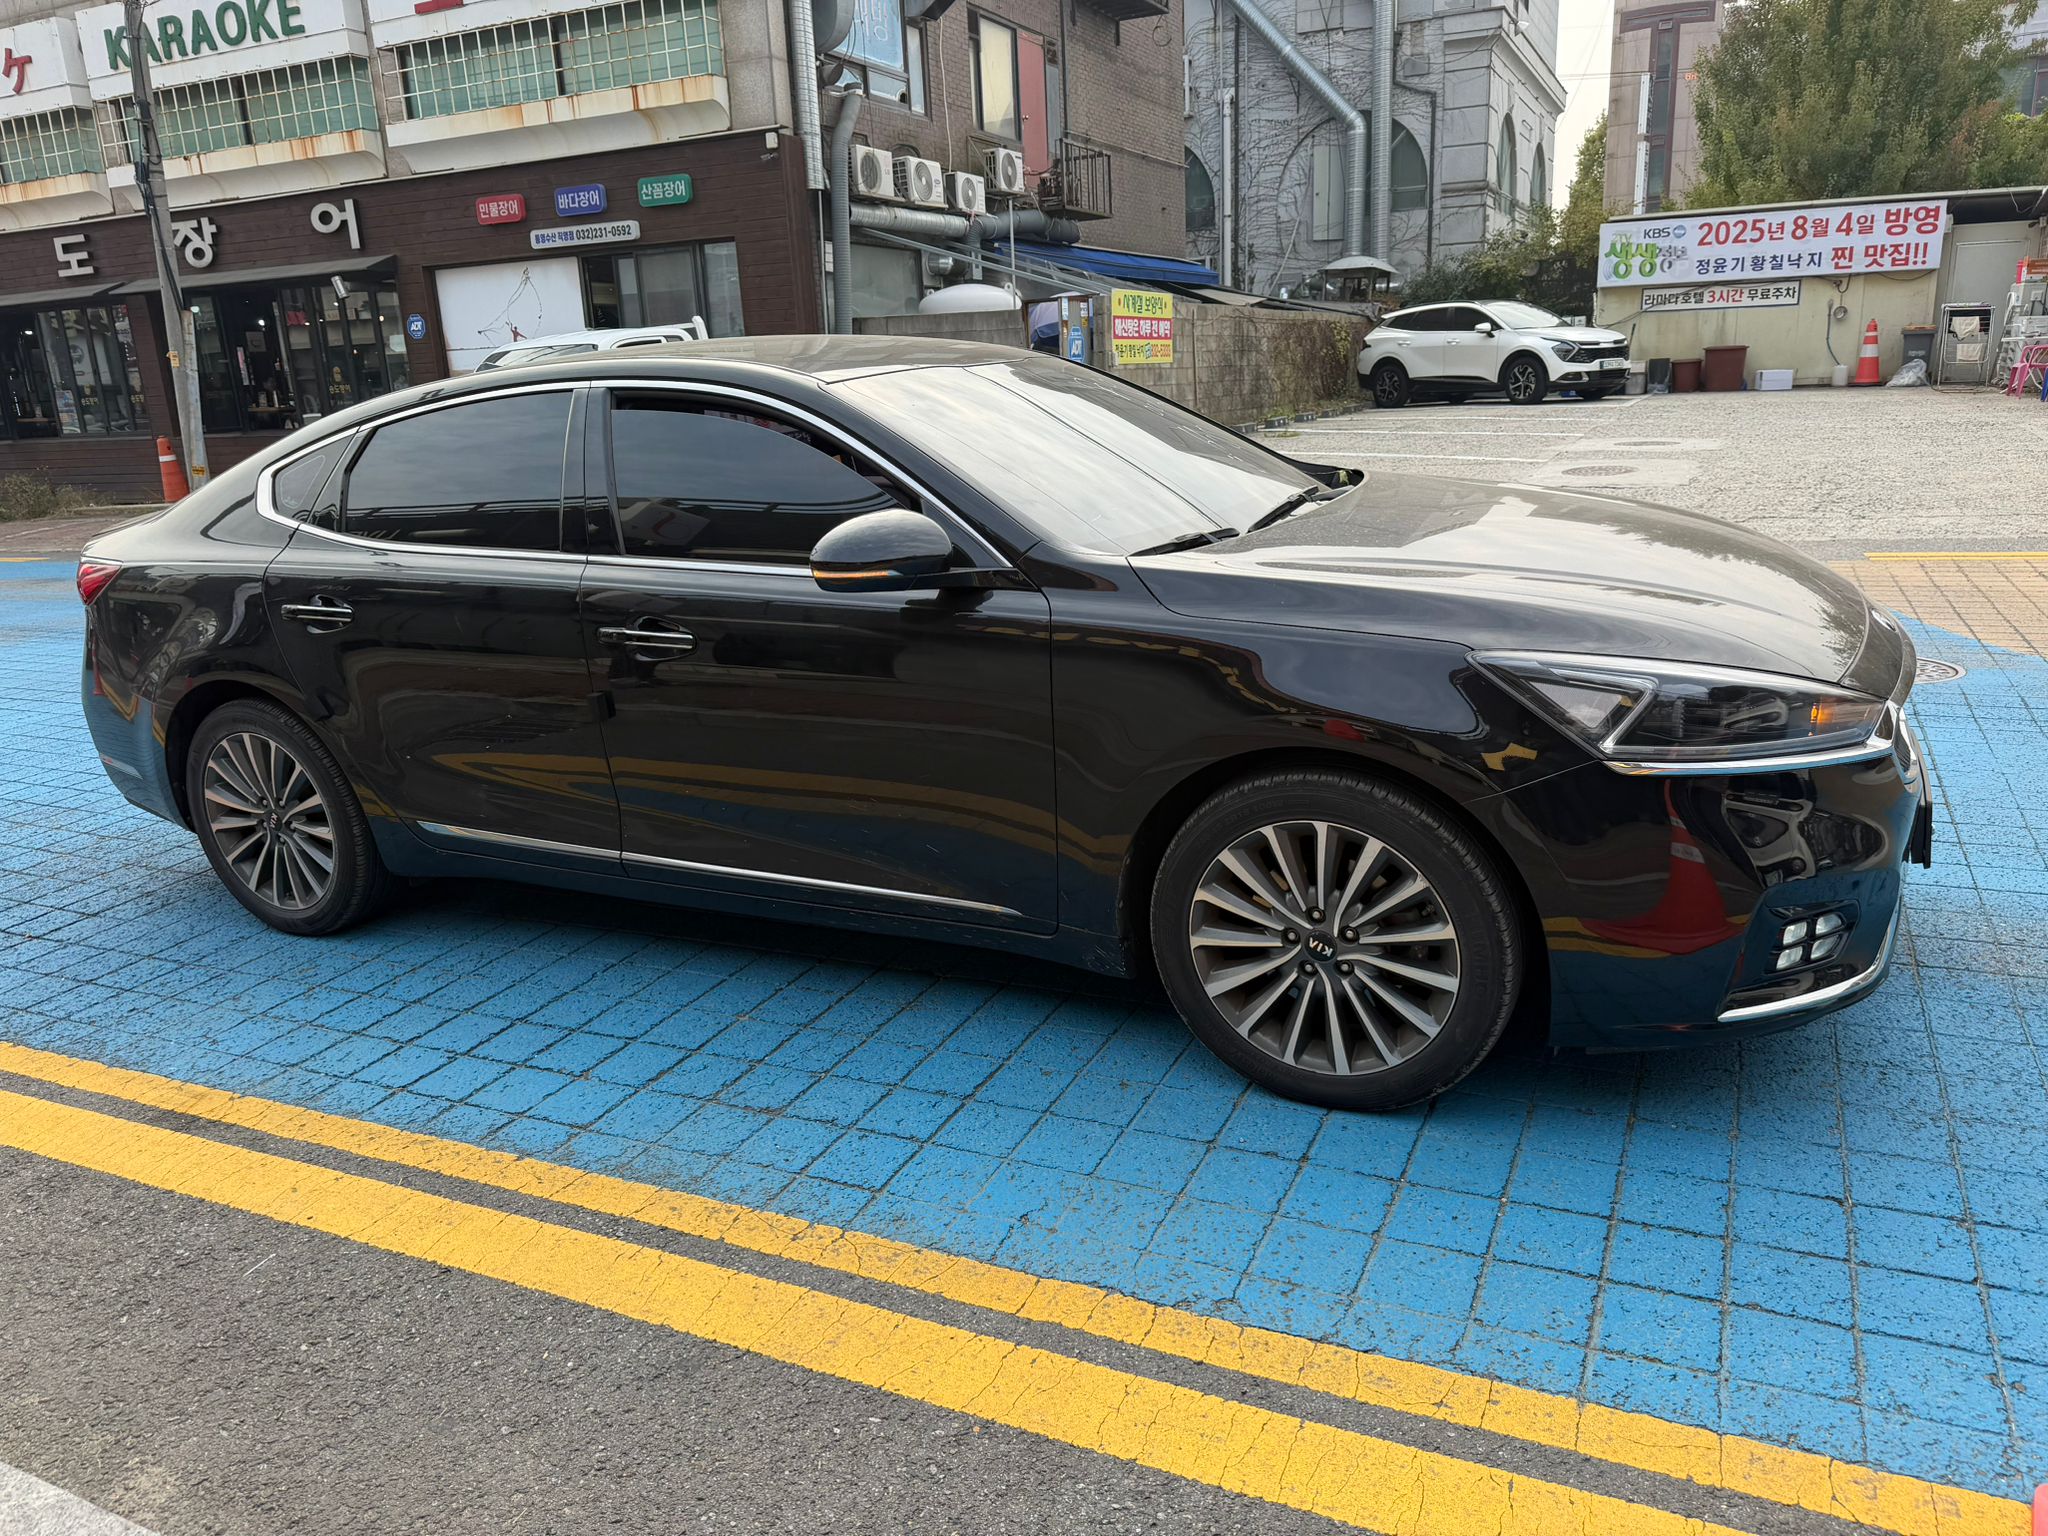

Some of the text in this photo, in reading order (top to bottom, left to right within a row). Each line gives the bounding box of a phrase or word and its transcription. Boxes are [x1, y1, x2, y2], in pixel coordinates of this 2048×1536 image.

[2, 48, 33, 94] ケ
[557, 189, 600, 209] 바다장어
[641, 179, 686, 200] 산꼼장어
[479, 199, 519, 218] 민물장어
[575, 223, 632, 241] 032)231-0592
[1643, 227, 1671, 239] KBS
[1697, 205, 1941, 247] 2025년 8월 4일 방영
[1830, 246, 1854, 270] 찐
[1863, 242, 1929, 268] 맛집!!
[1707, 289, 1745, 304] 3시간
[1747, 286, 1797, 301] 무료주차
[1308, 937, 1333, 957] KIA
